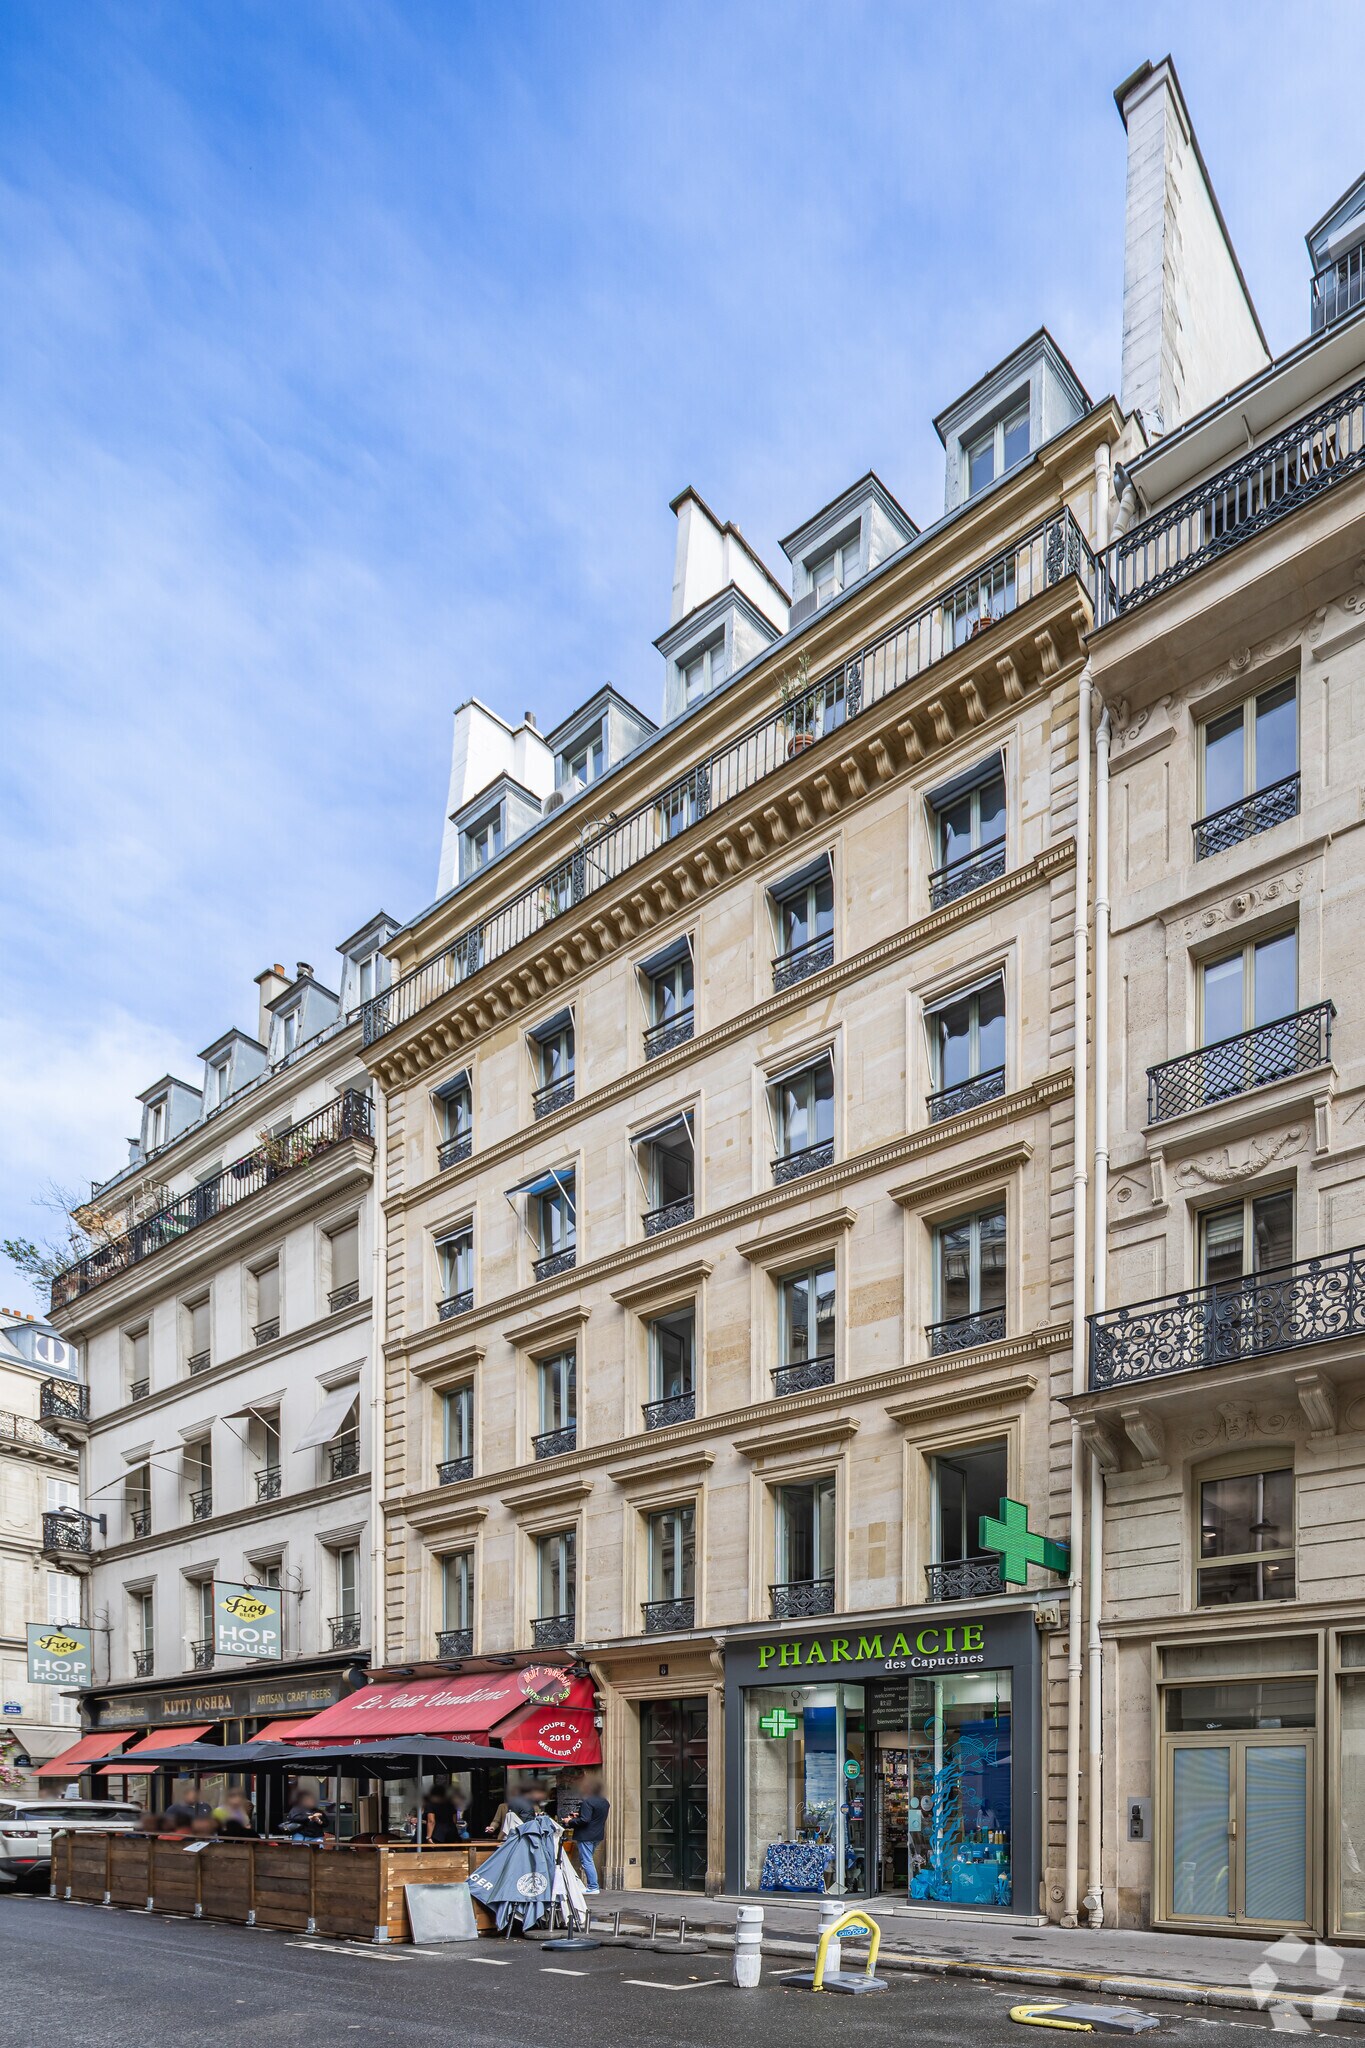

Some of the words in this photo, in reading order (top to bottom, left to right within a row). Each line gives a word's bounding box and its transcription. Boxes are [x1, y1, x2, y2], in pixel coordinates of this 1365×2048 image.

[226, 1595, 266, 1615] Frog
[40, 1635, 77, 1650] Frog
[219, 1625, 276, 1644] HOP
[219, 1641, 276, 1656] HOUSE
[757, 1624, 985, 1669] PHARMACIE
[33, 1659, 87, 1674] HOP
[884, 1659, 907, 1670] des
[911, 1653, 984, 1671] Capucines
[34, 1672, 87, 1683] HOUSE
[256, 1693, 284, 1705] ARTISAN
[286, 1691, 309, 1702] CRAFT
[311, 1688, 331, 1700] BEERS
[351, 1694, 382, 1710] Le
[163, 1699, 192, 1715] KITTY
[195, 1695, 232, 1710] O'SHEA
[538, 1722, 566, 1735] COUPE
[568, 1724, 580, 1734] DU
[549, 1734, 571, 1742] 2019
[537, 1740, 572, 1756] MEILLEUR
[572, 1738, 583, 1753] POT
